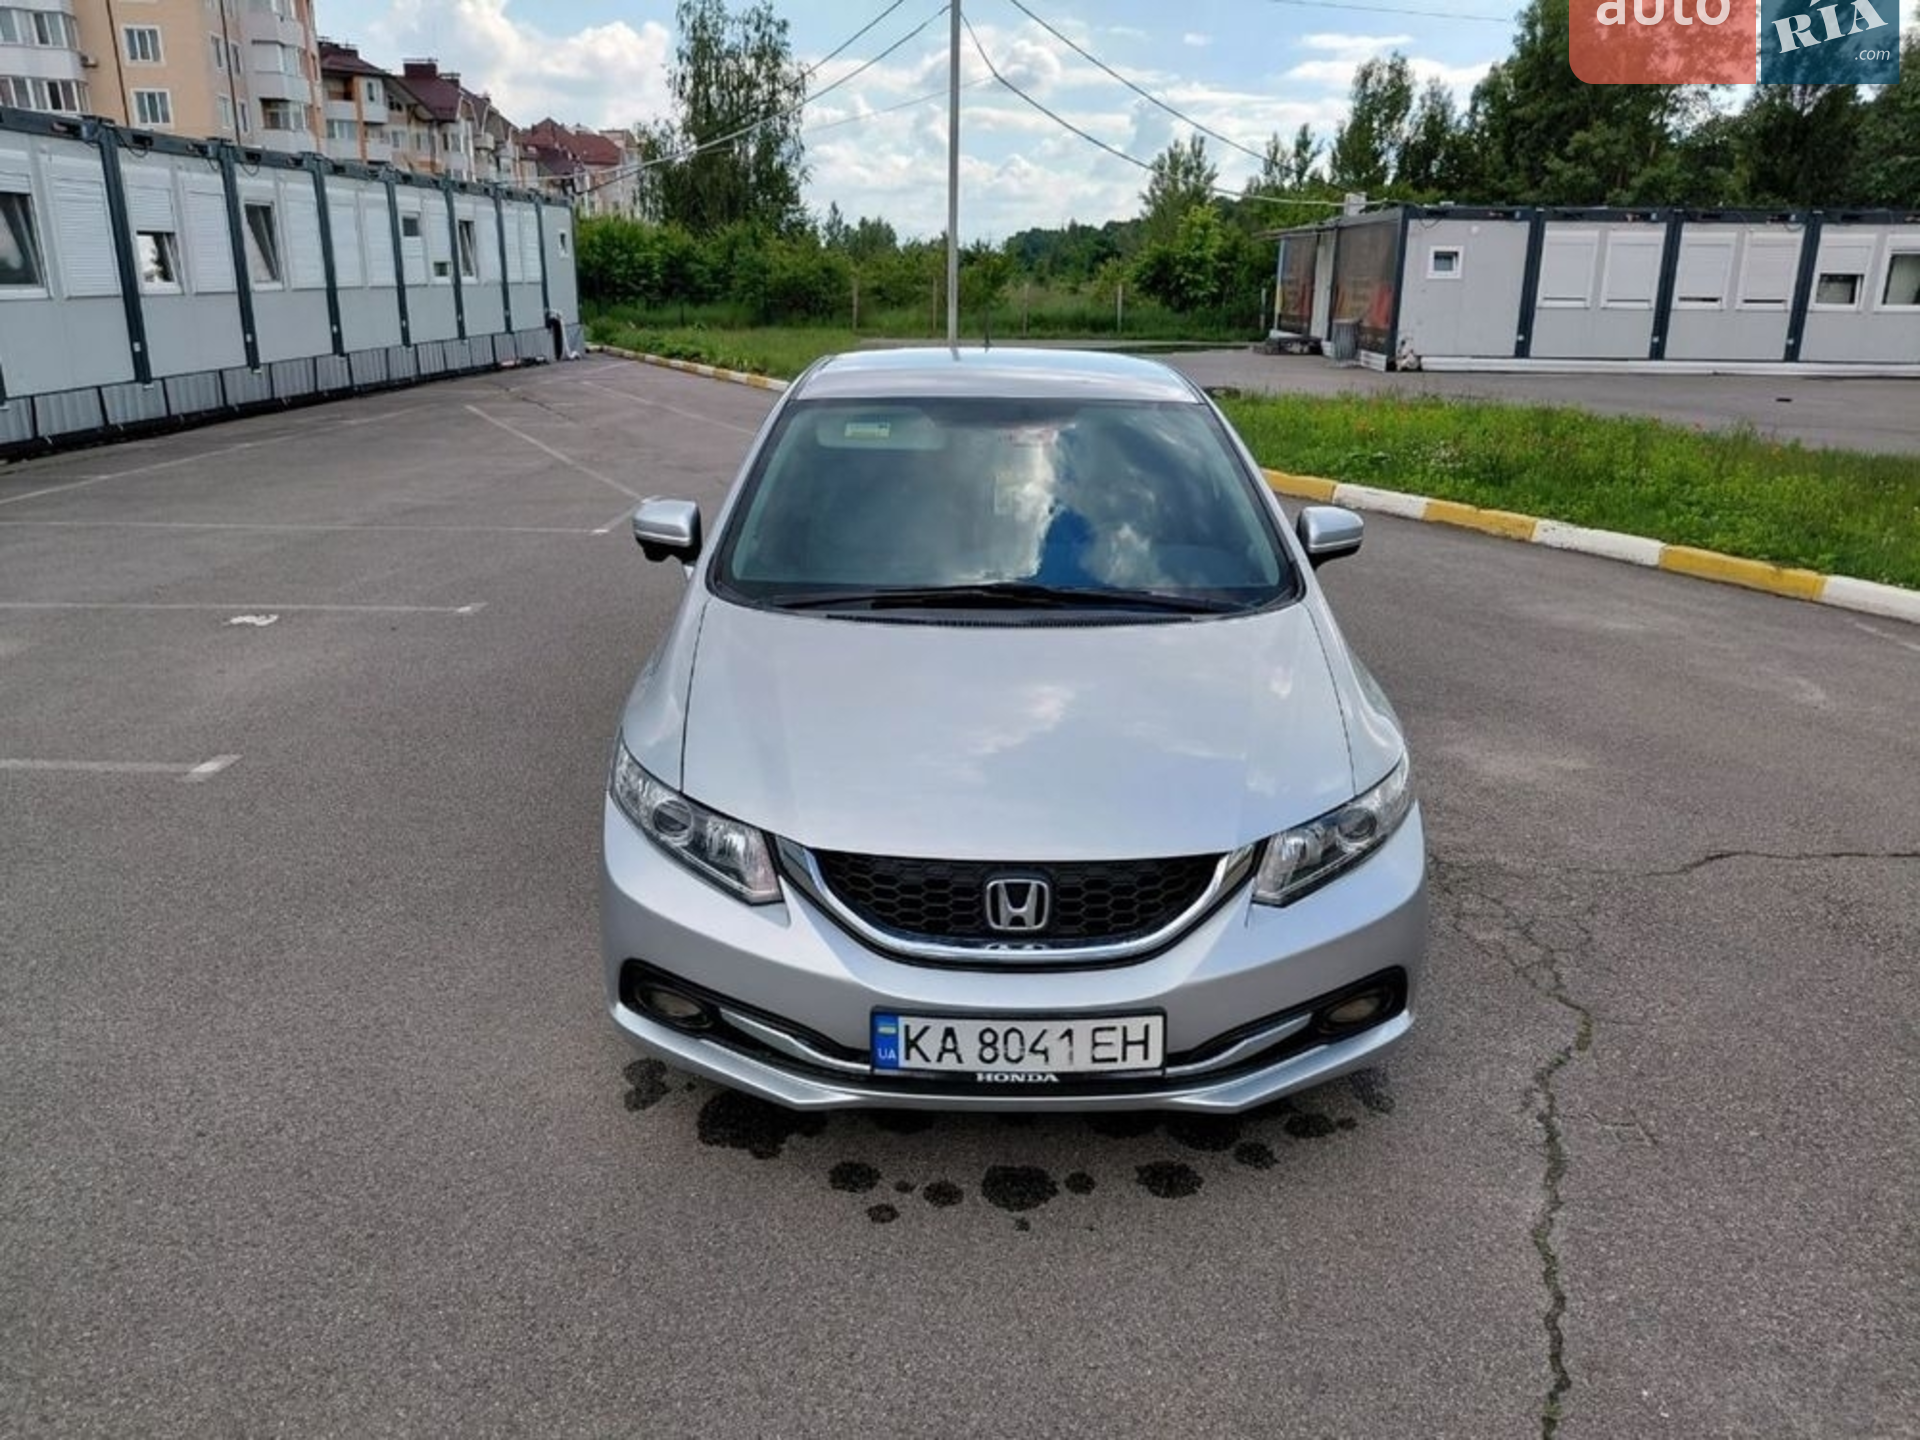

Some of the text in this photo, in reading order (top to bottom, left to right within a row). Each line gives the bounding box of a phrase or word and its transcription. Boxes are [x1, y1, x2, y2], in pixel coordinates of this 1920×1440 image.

[904, 1023, 1149, 1065] KA 8041 EH
[879, 1048, 896, 1060] UA
[976, 1072, 1059, 1083] HONDA
